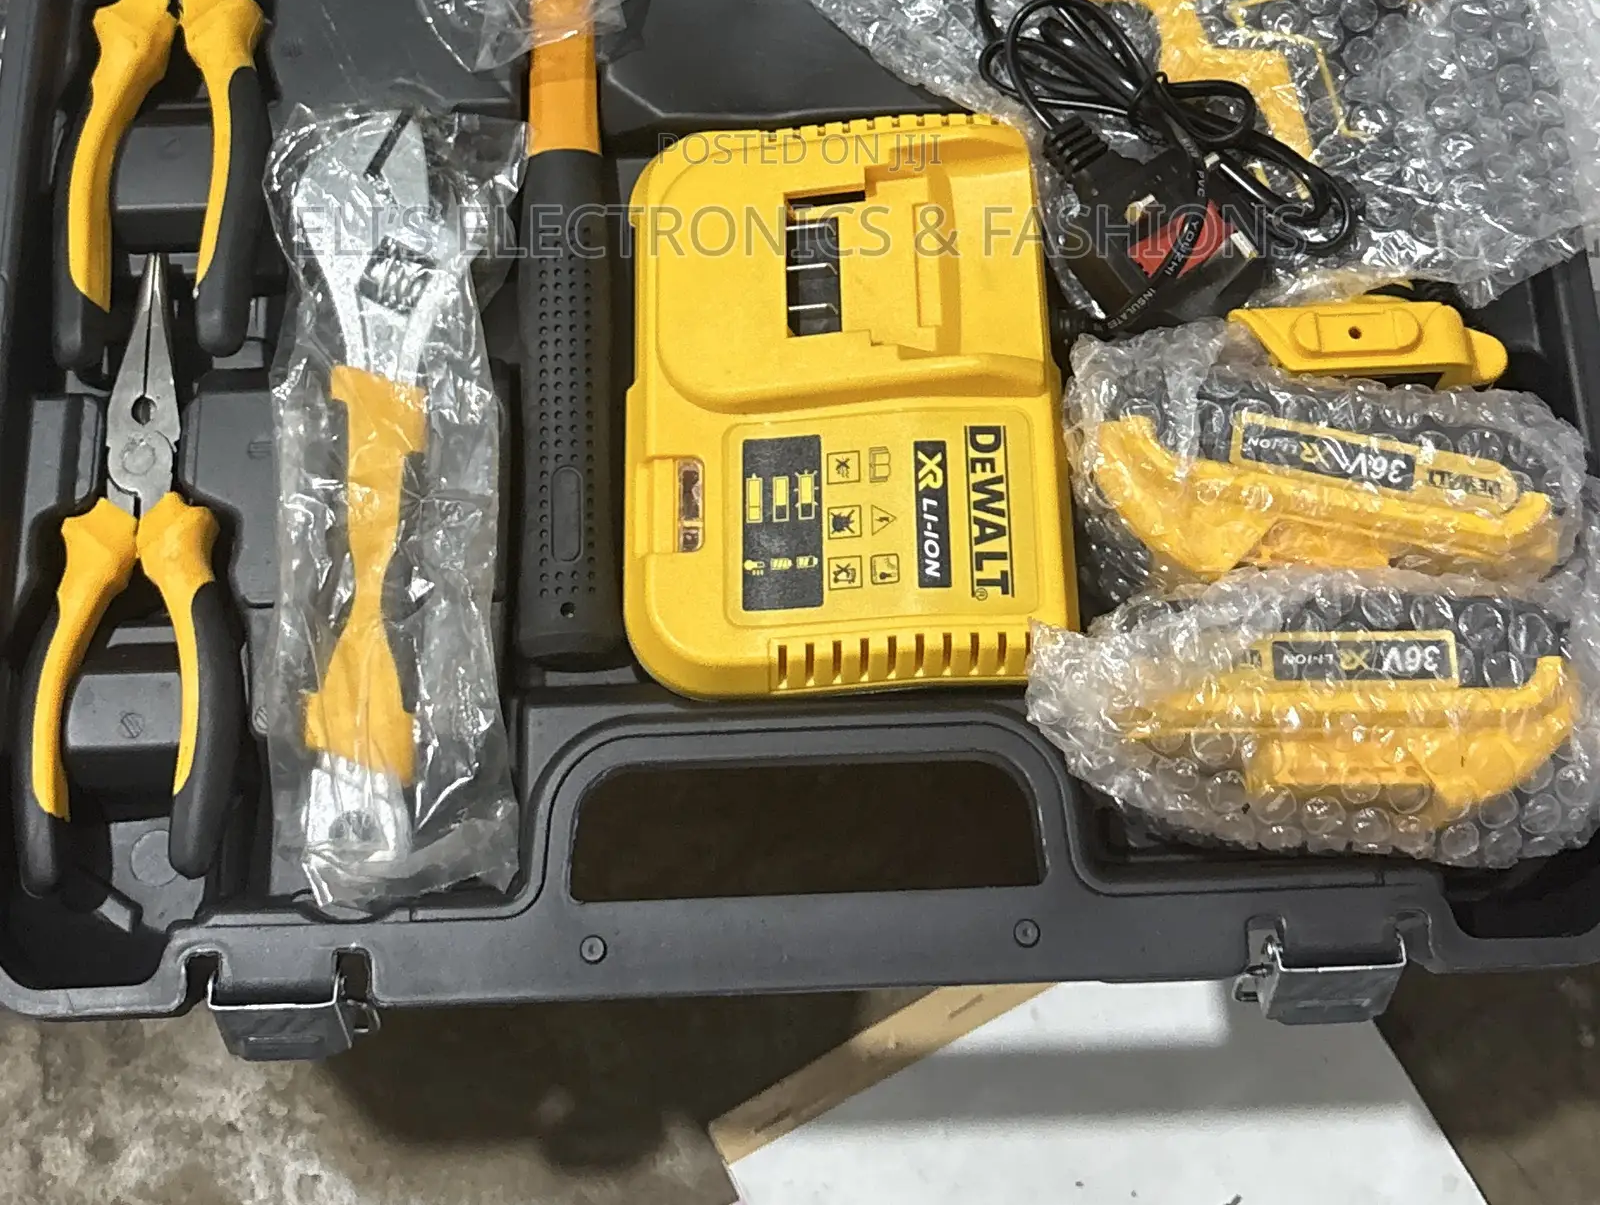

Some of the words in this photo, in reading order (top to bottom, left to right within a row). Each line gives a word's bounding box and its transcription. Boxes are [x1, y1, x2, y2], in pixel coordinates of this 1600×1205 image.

[1196, 169, 1206, 198] PVC
[916, 450, 945, 491] XR
[1347, 450, 1408, 484] 36V
[921, 497, 942, 579] LI-ION
[1281, 652, 1334, 667] LI-ION
[1381, 645, 1442, 673] 36V
